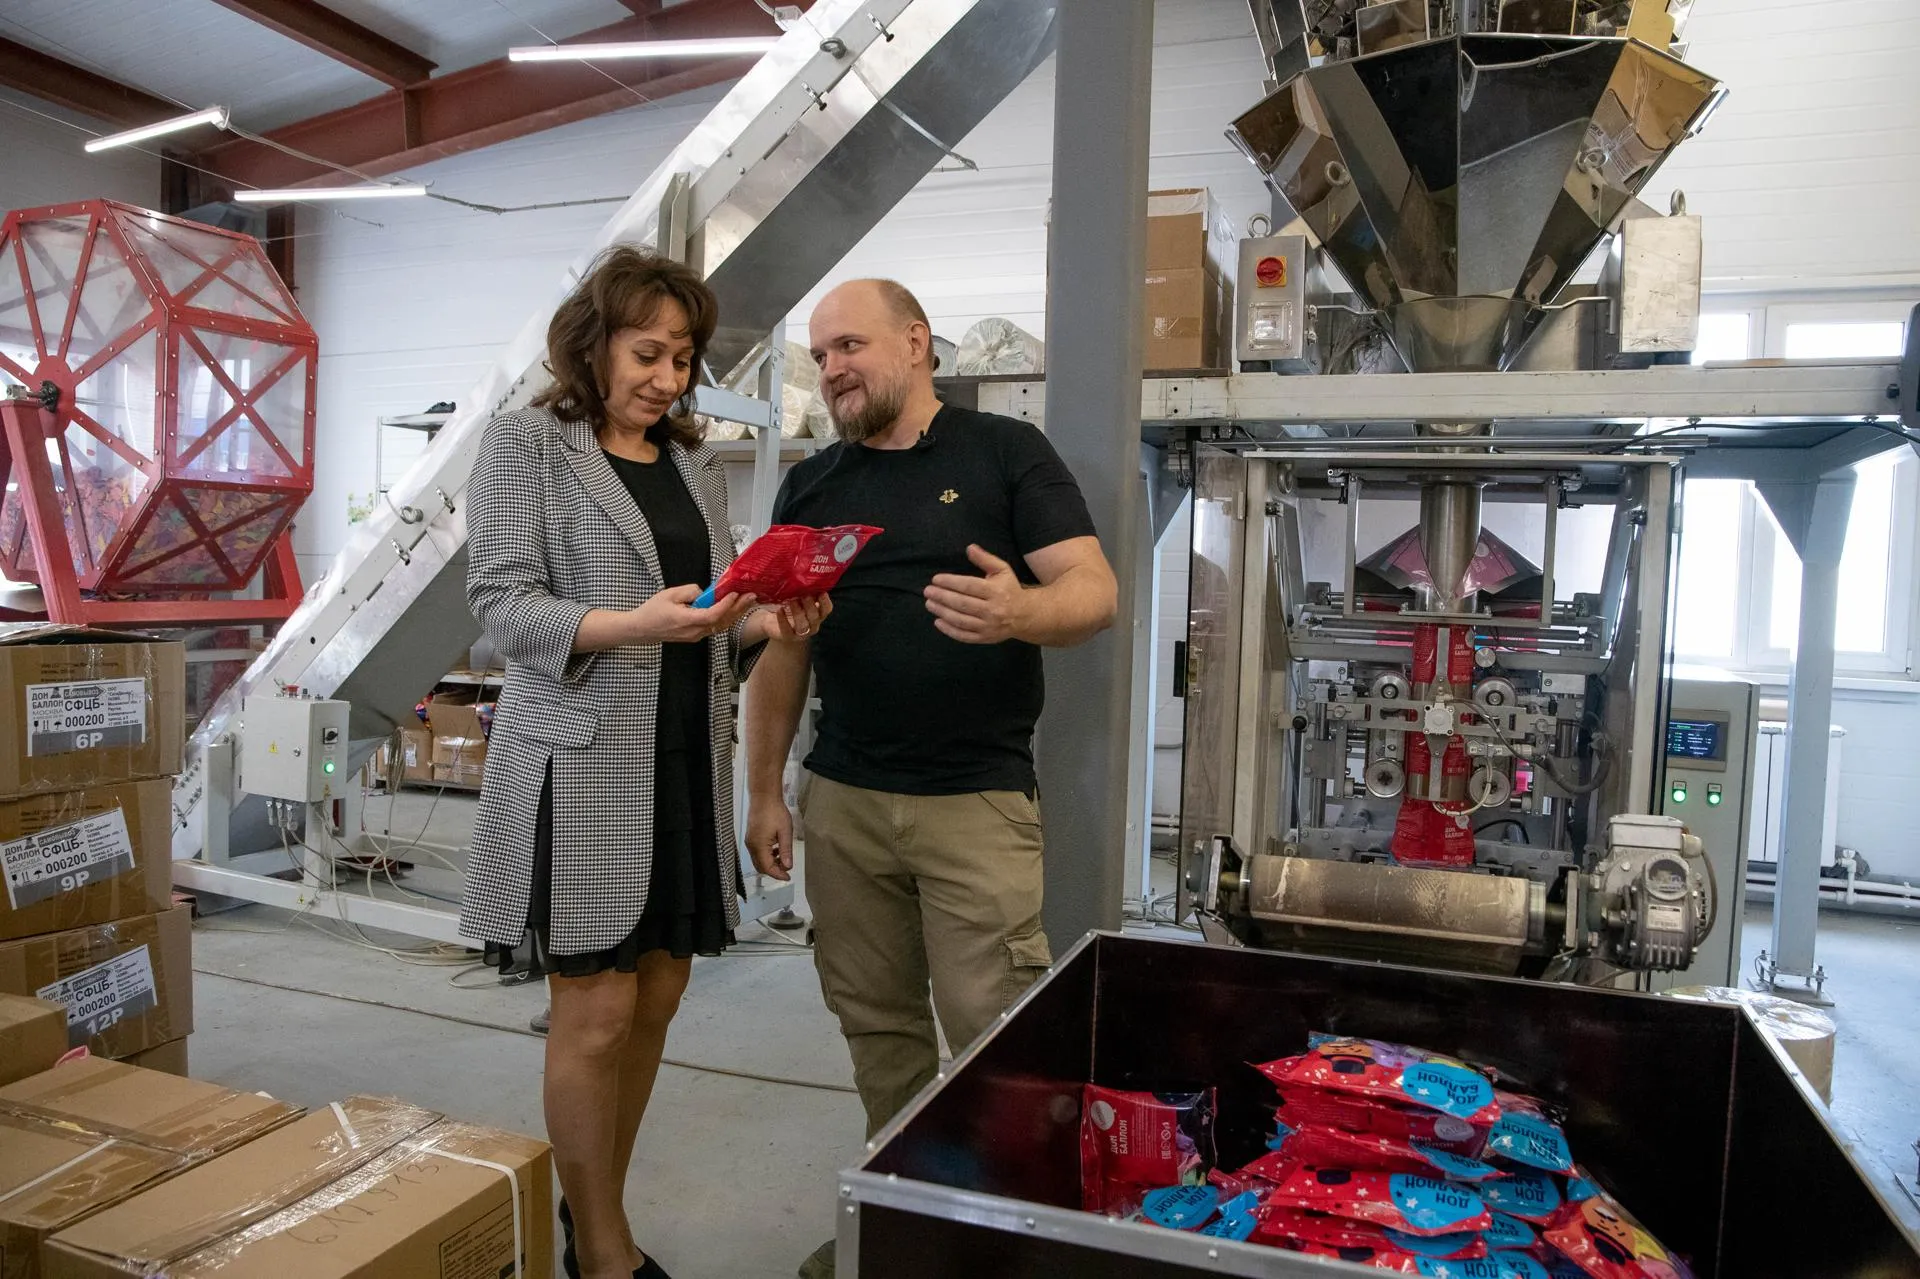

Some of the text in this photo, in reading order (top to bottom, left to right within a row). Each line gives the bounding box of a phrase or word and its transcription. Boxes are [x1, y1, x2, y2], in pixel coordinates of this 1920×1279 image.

[32, 692, 49, 701] ДОН
[32, 699, 64, 709] БАЛЛОН
[64, 698, 105, 712] СФЦБ-
[65, 714, 105, 728] 000200
[4, 845, 22, 857] ДОН
[6, 849, 41, 864] БАЛЛОН
[41, 838, 85, 858] СФЦБ-
[45, 852, 88, 874] 000200
[75, 979, 114, 1001] СФЦБ-
[78, 993, 116, 1016] 000200
[1417, 1071, 1479, 1094] БАЛЛОН
[1447, 1089, 1479, 1105] ДОН
[1119, 1119, 1128, 1155] БАЛЛОН
[1502, 1120, 1558, 1149] БАЛЛОН
[1109, 1135, 1118, 1154] ДОН
[1153, 1185, 1196, 1213] АЛЛОН
[1184, 1187, 1208, 1206] ДОН
[1436, 1192, 1470, 1208] ДОН
[1514, 1186, 1545, 1203] ДОН
[1464, 1262, 1499, 1279] ДОН
